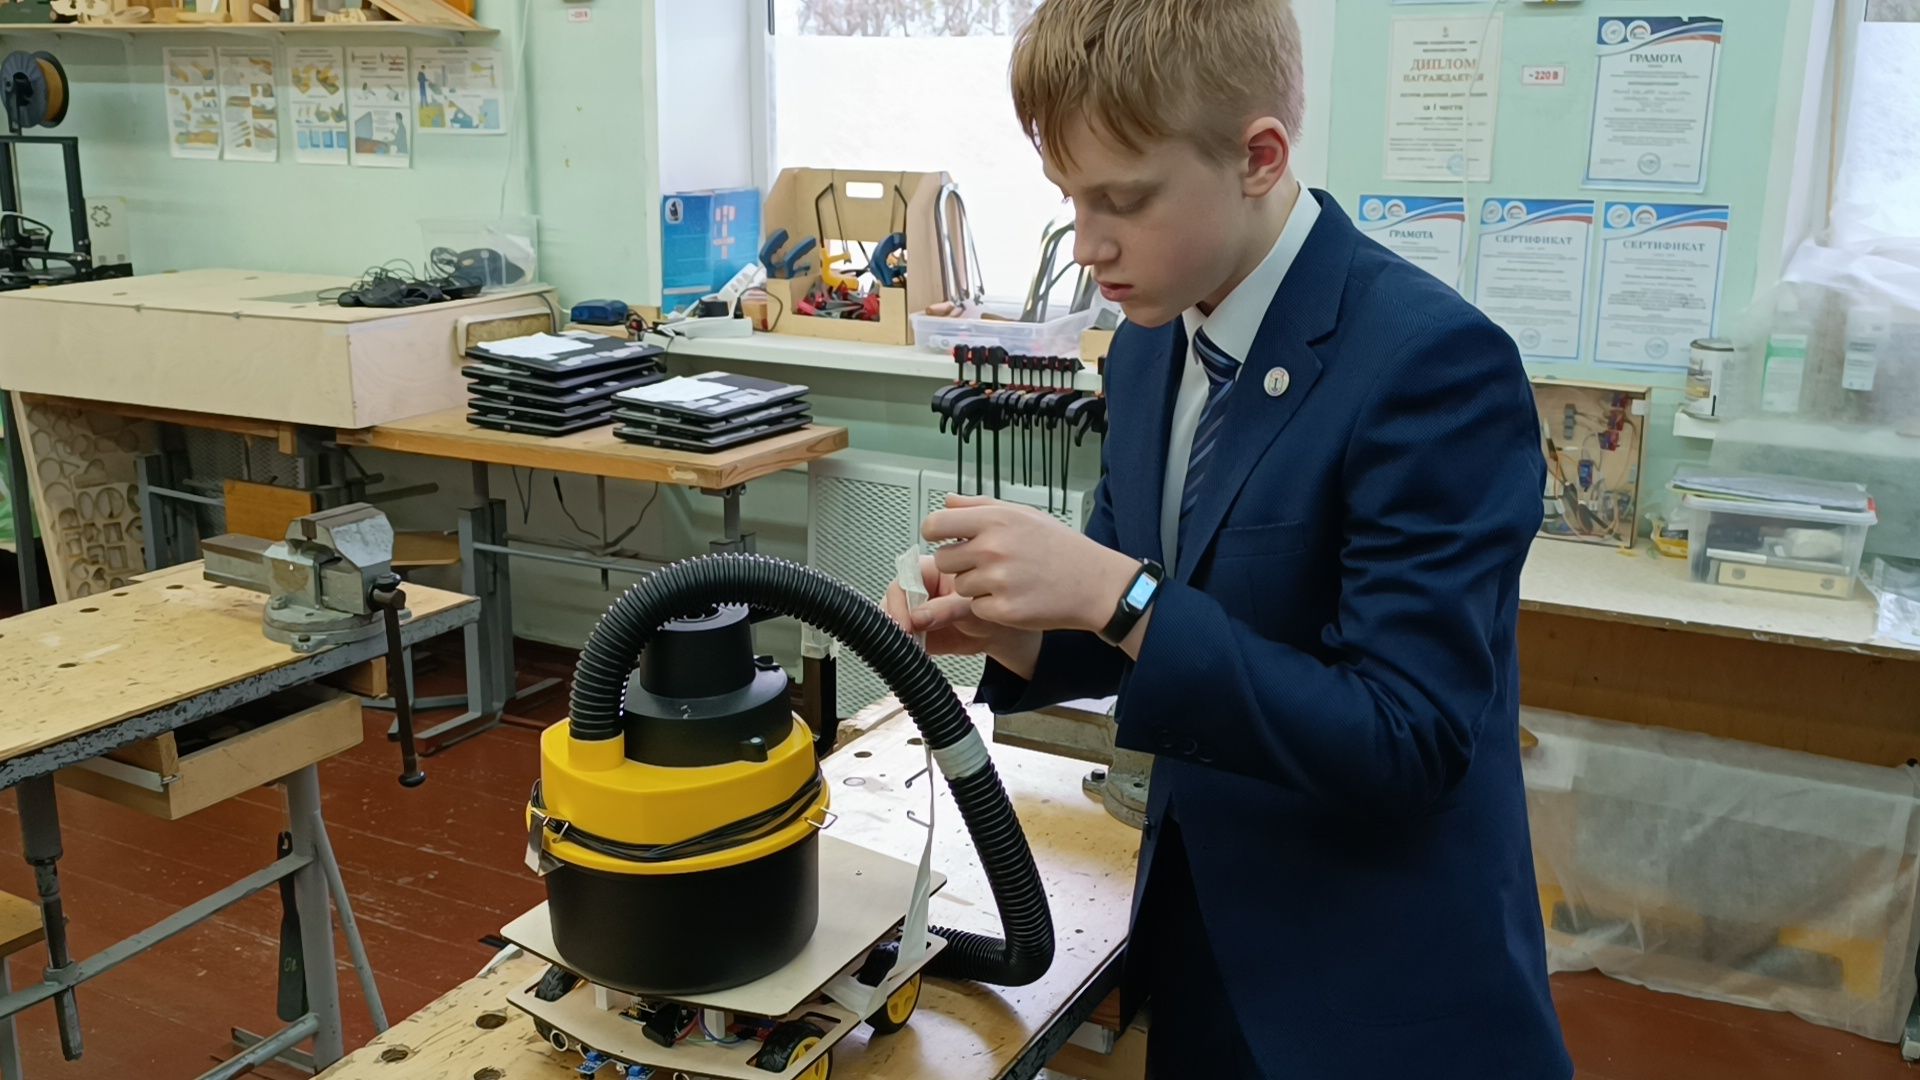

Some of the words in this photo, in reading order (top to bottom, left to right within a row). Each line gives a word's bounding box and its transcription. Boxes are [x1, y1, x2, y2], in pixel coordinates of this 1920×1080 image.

[1629, 53, 1682, 64] ГРАМОТА
[1410, 58, 1476, 71] ДИПЛОМ
[1389, 229, 1433, 239] ГРАМОТА
[1495, 234, 1573, 245] СЕРТИФИКАТ
[1622, 240, 1706, 252] СЕРТИФИКАТ
